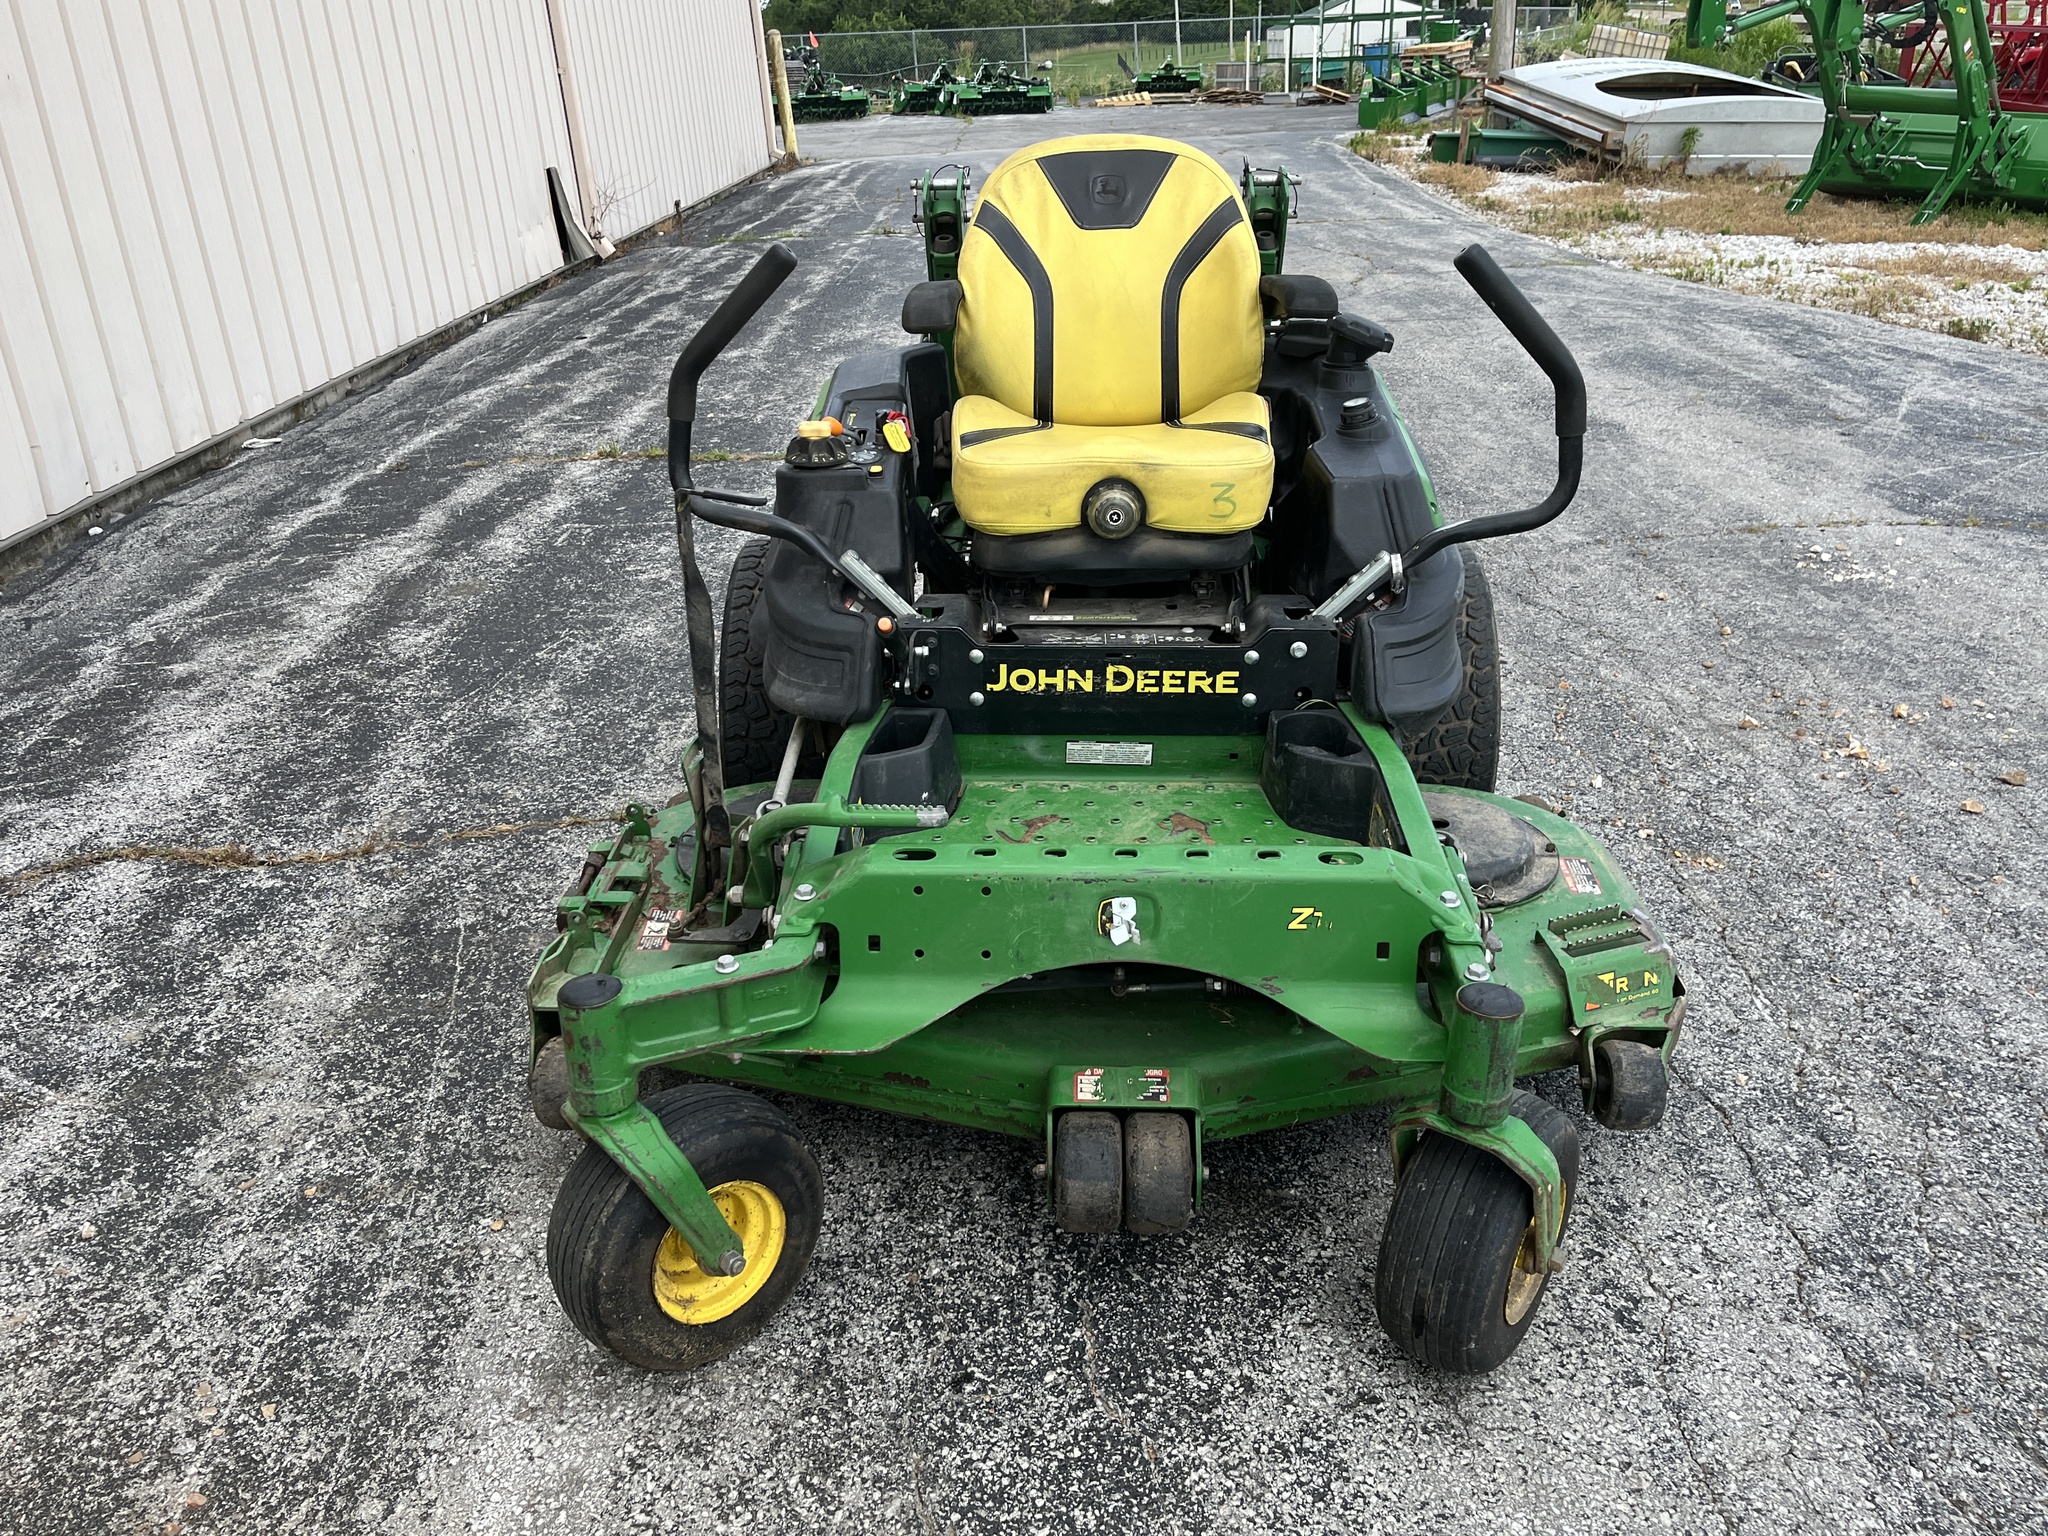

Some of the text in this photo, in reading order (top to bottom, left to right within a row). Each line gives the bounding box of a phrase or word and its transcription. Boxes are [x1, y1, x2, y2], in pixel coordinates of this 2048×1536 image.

[1207, 481, 1238, 518] 3
[986, 663, 1240, 694] JOHN DEERE
